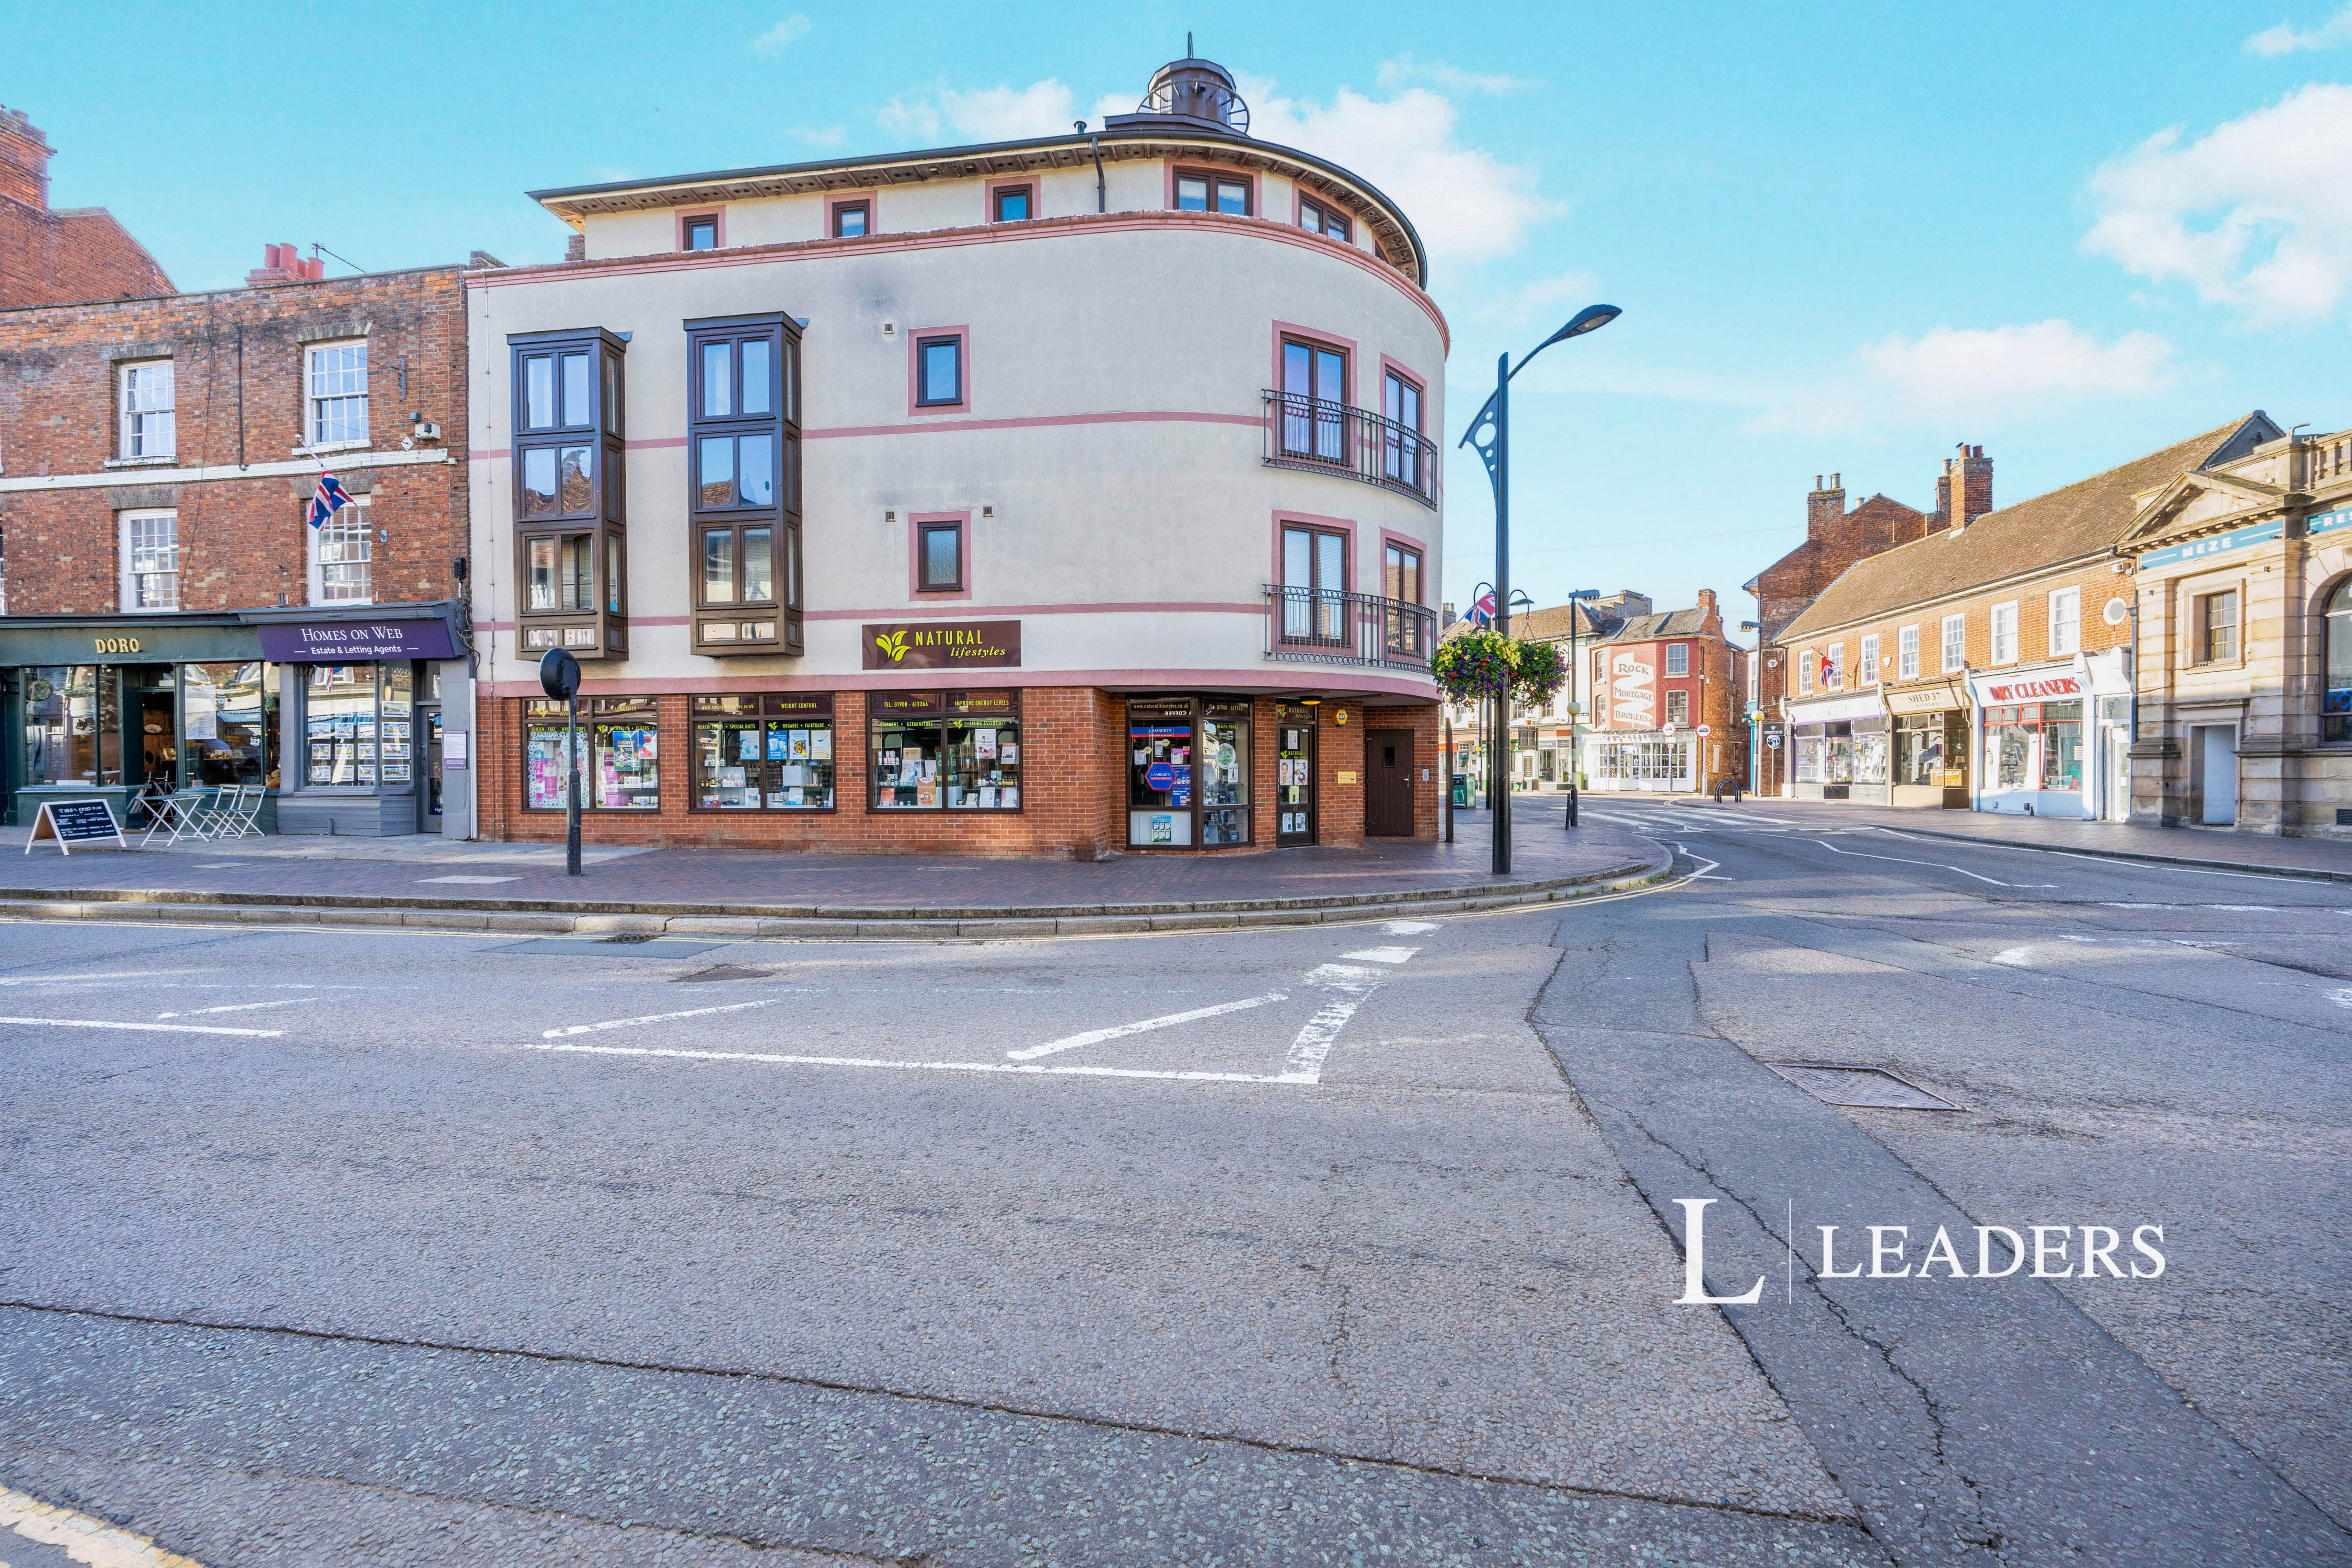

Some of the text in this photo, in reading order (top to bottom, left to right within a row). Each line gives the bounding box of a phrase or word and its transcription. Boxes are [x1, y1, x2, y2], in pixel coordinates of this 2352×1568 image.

[2182, 537, 2232, 558] MEZE
[916, 630, 983, 646] NATURAL
[344, 645, 373, 655] Letting
[374, 645, 401, 654] Agents
[950, 646, 1006, 658] lifestyles
[1618, 663, 1648, 675] ROCK
[1614, 687, 1653, 702] MORTGAGE
[1989, 677, 2081, 701] DRY CLEANERS
[1908, 692, 1940, 703] SHED 37
[1615, 710, 1648, 722] BROKERS
